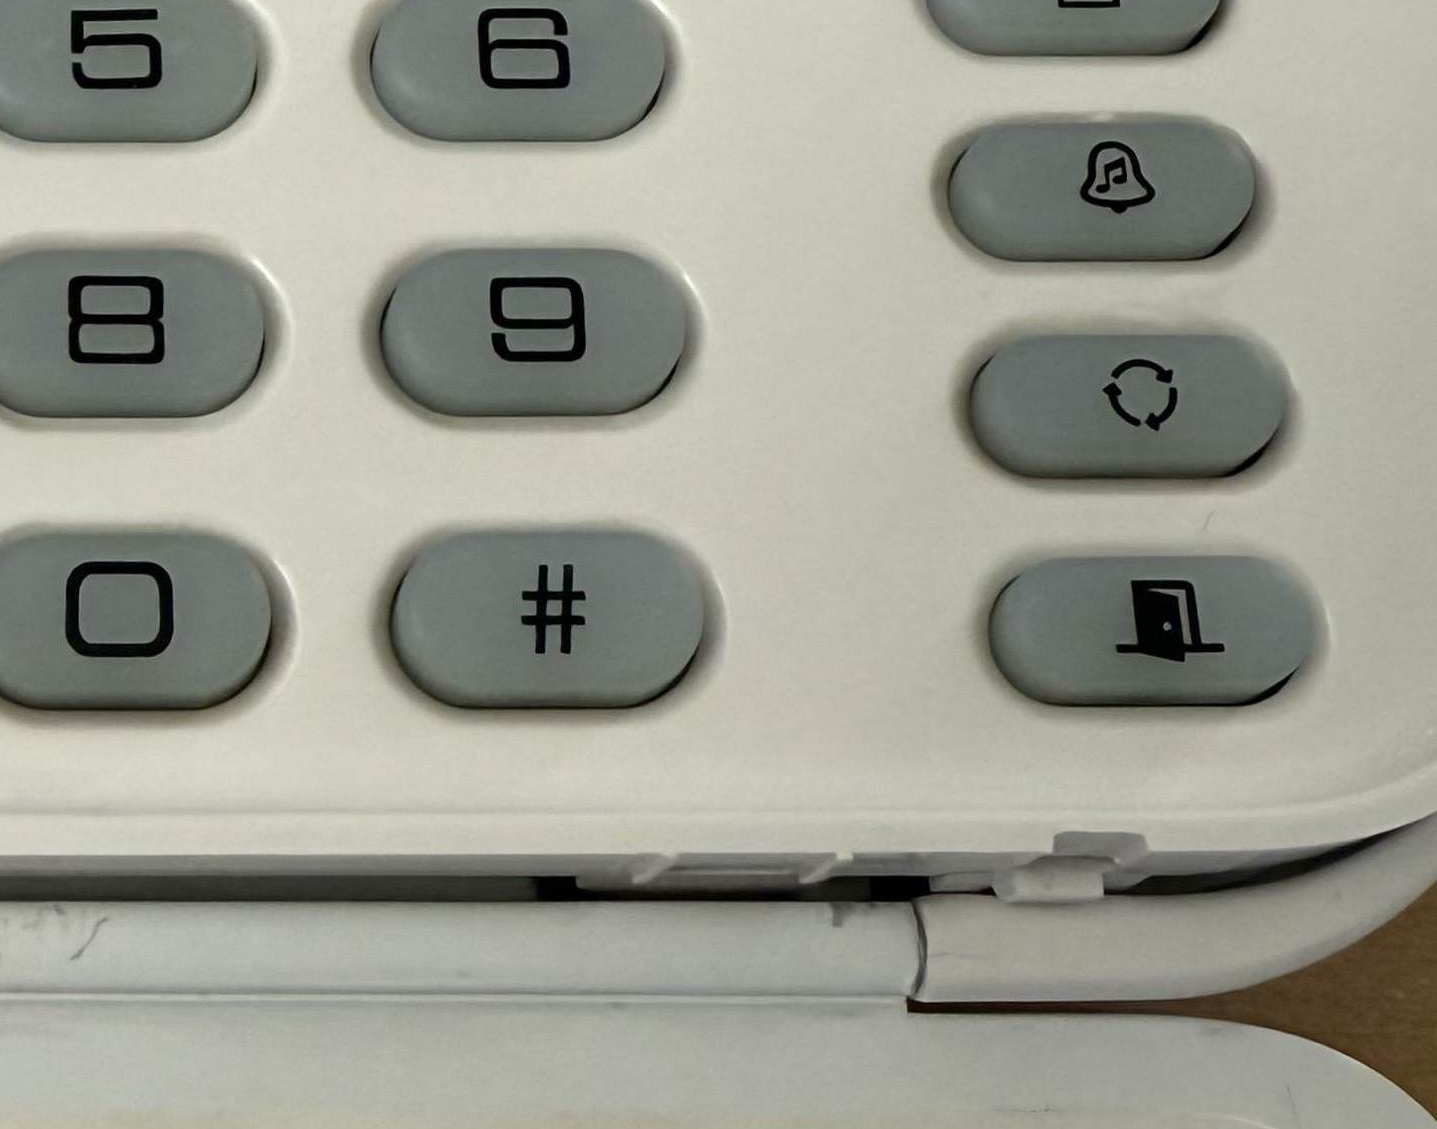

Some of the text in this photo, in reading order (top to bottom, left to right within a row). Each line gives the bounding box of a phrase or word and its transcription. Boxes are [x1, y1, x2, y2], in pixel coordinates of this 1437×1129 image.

[70, 8, 163, 90] 5
[477, 7, 571, 90] 6
[67, 274, 166, 365] 8
[489, 276, 587, 363] 9
[520, 563, 587, 655] #
